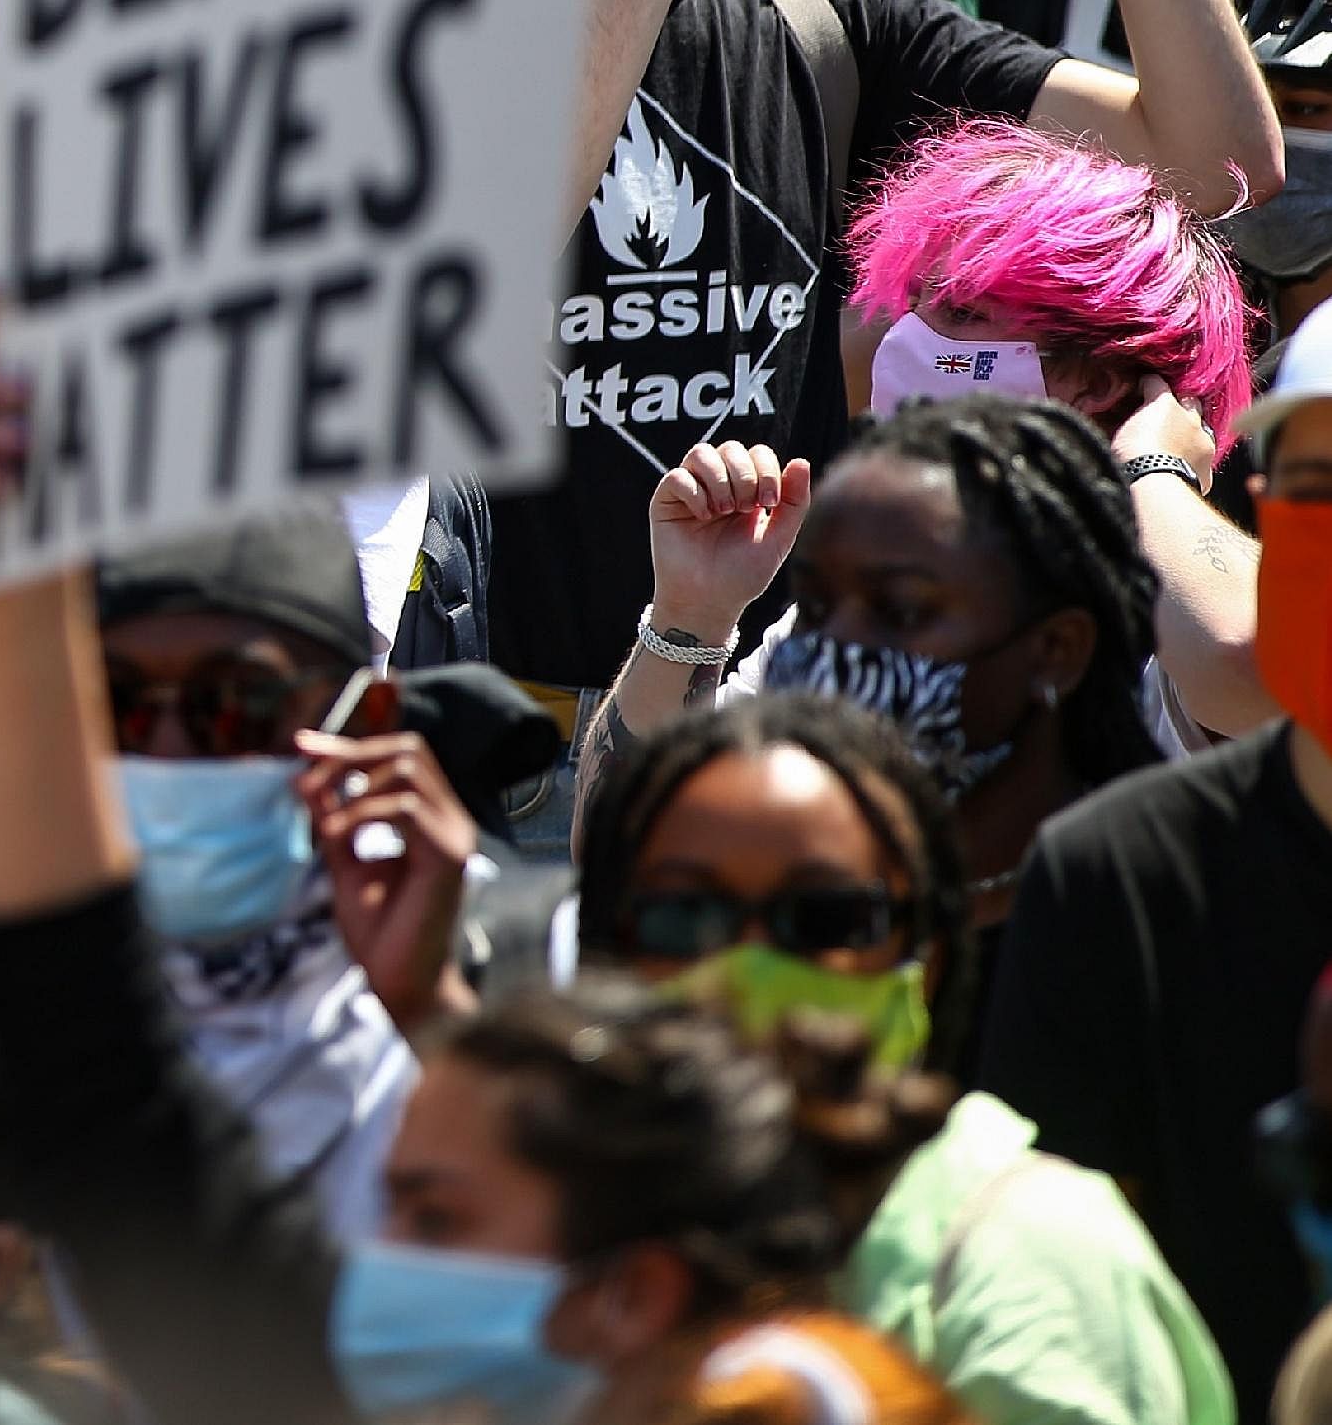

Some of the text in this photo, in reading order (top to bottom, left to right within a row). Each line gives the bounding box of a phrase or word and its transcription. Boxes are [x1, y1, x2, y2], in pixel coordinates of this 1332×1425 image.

[550, 270, 807, 345] assive
[29, 254, 511, 545] ATTER
[551, 353, 777, 427] ttack
